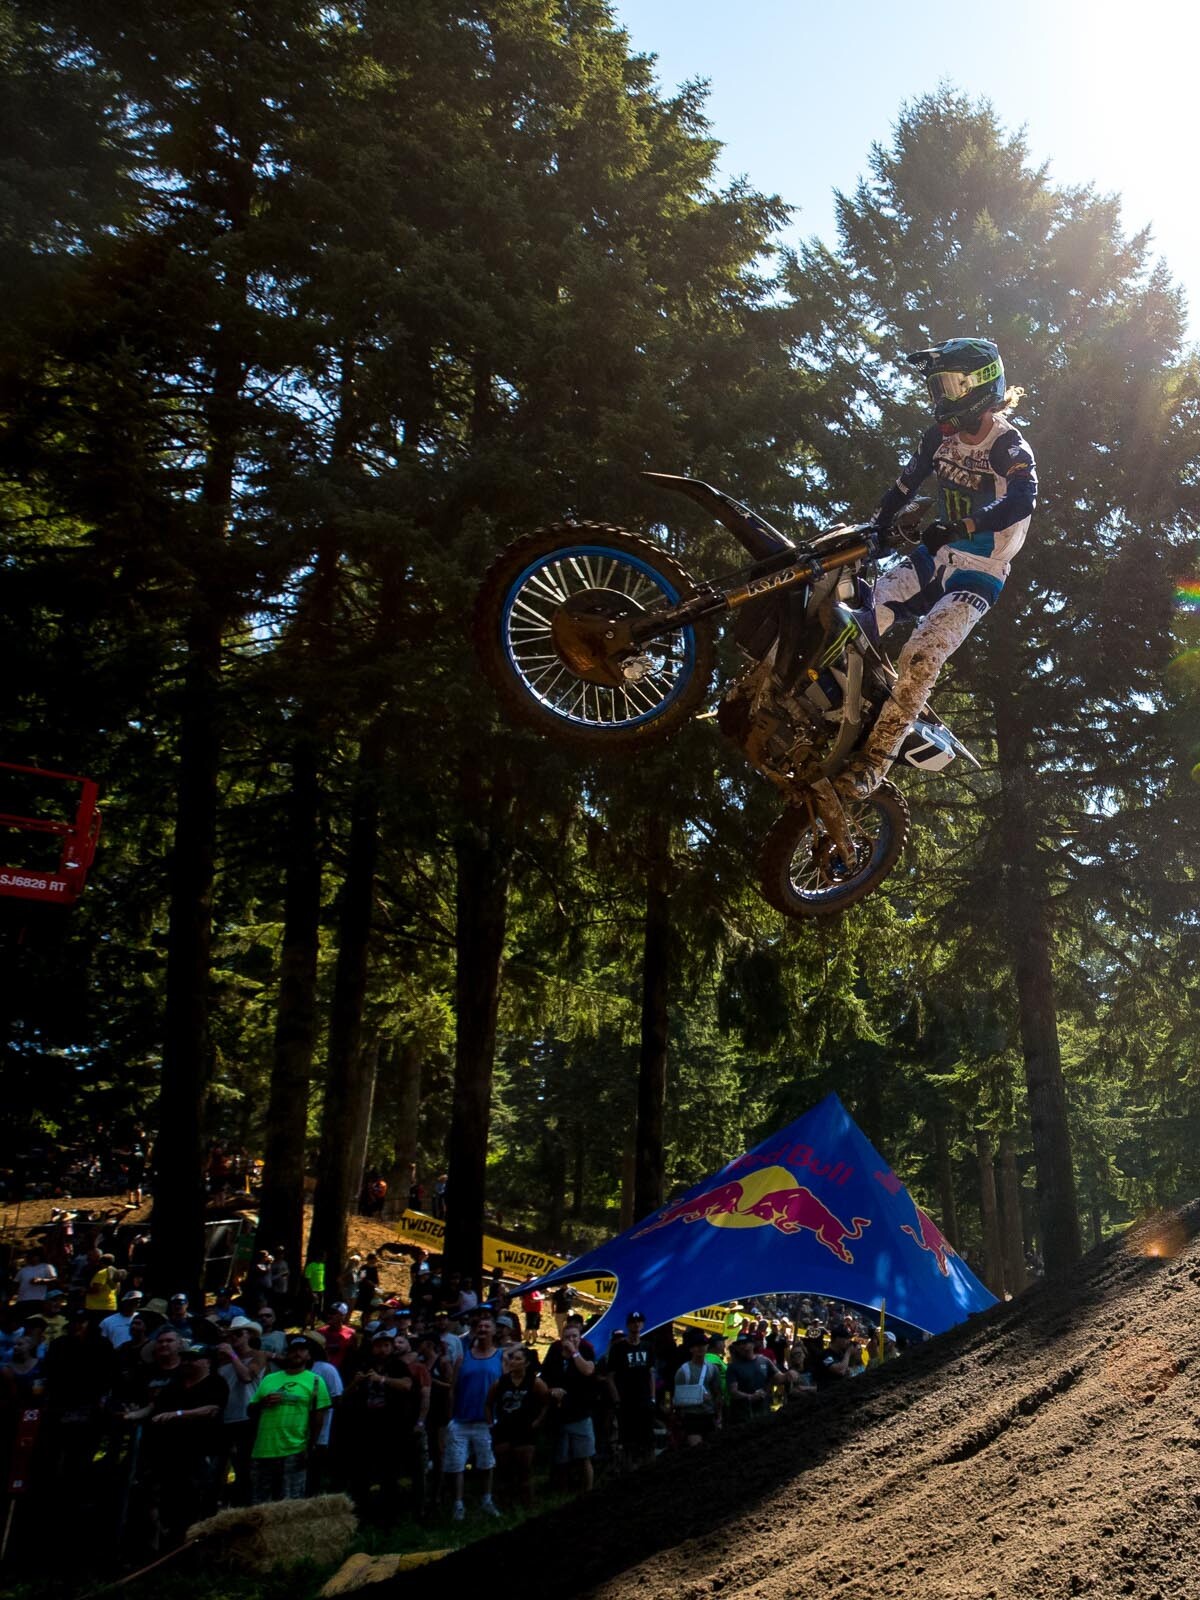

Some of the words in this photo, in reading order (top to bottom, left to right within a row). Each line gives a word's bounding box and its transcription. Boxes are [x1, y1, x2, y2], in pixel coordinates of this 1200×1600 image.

[951, 592, 987, 615] THOR
[0, 874, 48, 890] SJ6826
[49, 881, 68, 892] RT
[786, 1144, 855, 1186] Bull
[400, 1217, 445, 1238] TWISTED
[496, 1249, 545, 1269] TWISTED
[694, 1309, 726, 1322] TWIST
[627, 1351, 647, 1363] FLY
